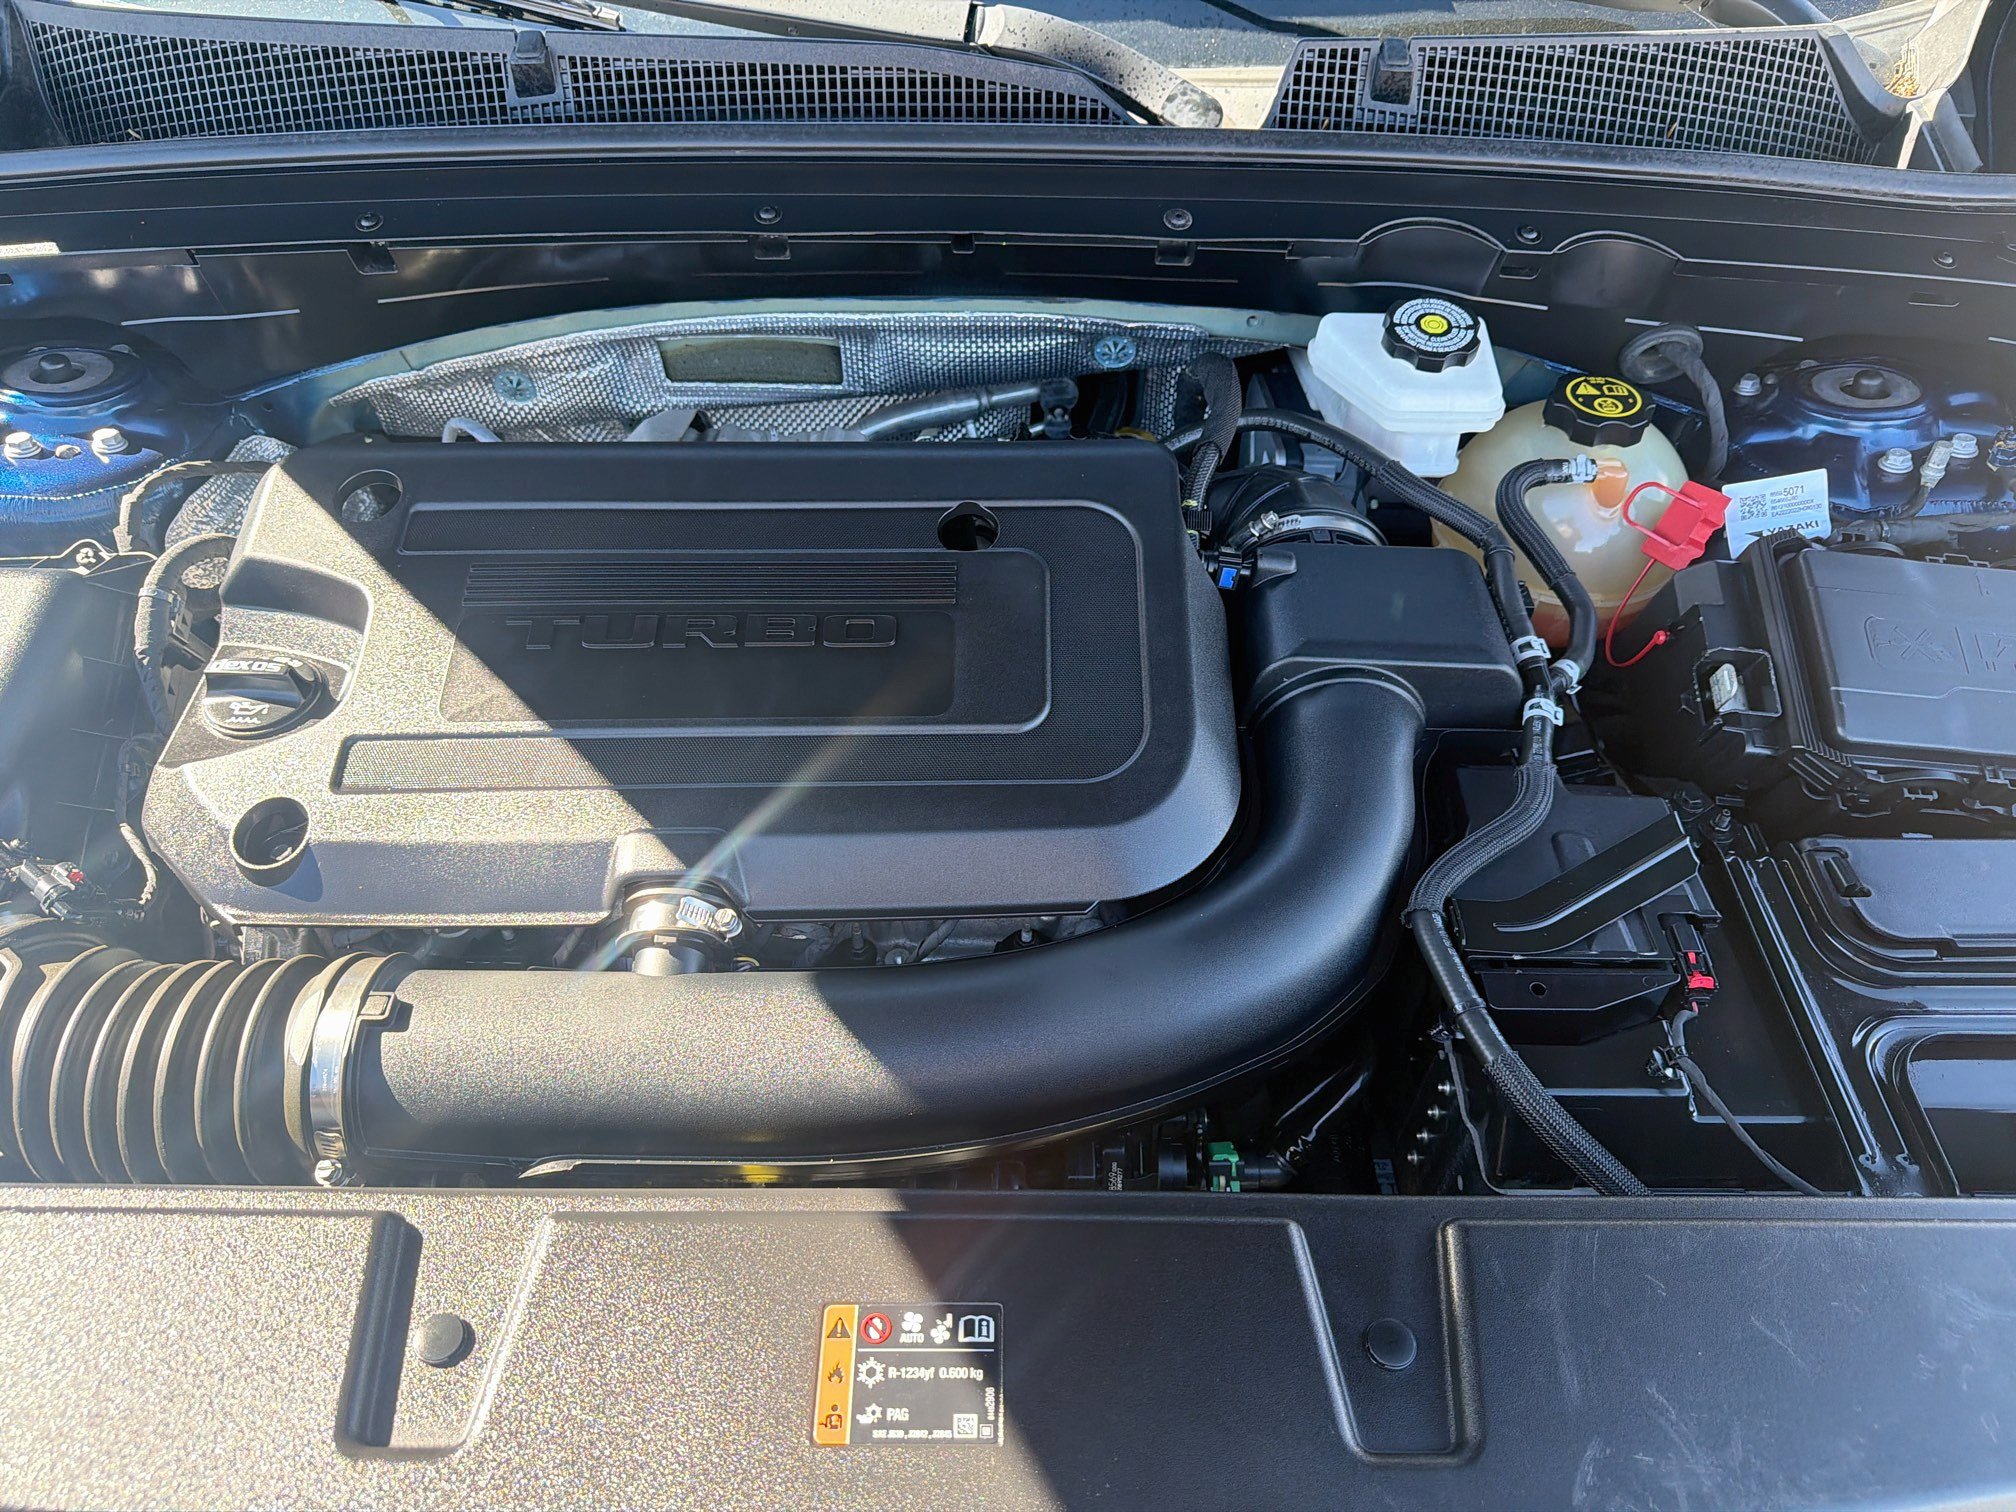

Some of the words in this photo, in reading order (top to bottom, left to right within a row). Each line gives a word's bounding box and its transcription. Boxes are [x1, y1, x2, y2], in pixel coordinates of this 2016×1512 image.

[1783, 485, 1804, 497] 5071
[506, 614, 897, 649] TURBO
[210, 659, 285, 673] dexos
[900, 1333, 924, 1343] AUTO
[888, 1367, 934, 1380] R-1234yf
[939, 1367, 968, 1378] 0.600
[970, 1367, 984, 1380] kg
[886, 1408, 910, 1421] PAG
